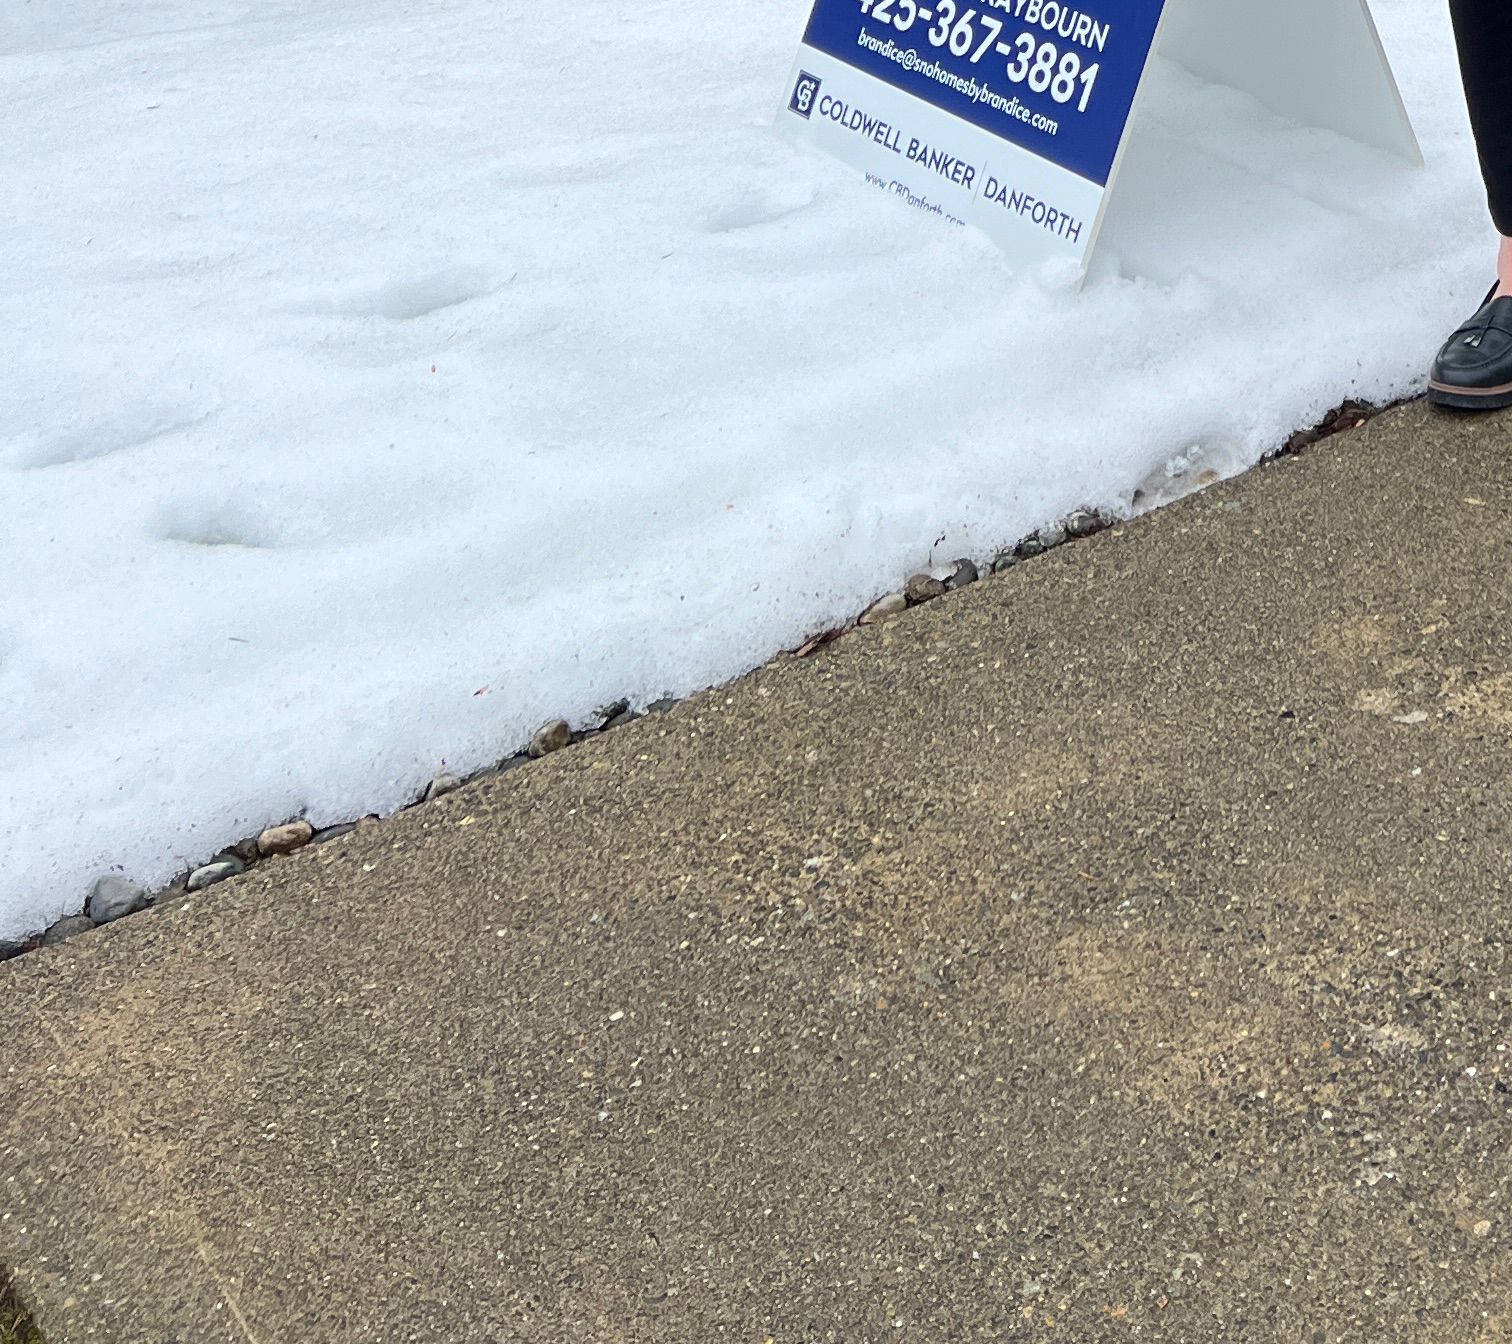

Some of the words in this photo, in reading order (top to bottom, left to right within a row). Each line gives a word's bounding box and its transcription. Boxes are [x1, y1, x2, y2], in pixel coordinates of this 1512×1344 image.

[858, 27, 1058, 135] brandice@snohomesbybrandice.com
[819, 94, 901, 153] COLDWELL
[906, 138, 975, 190] BANKER
[984, 176, 1083, 243] DANFORTH
